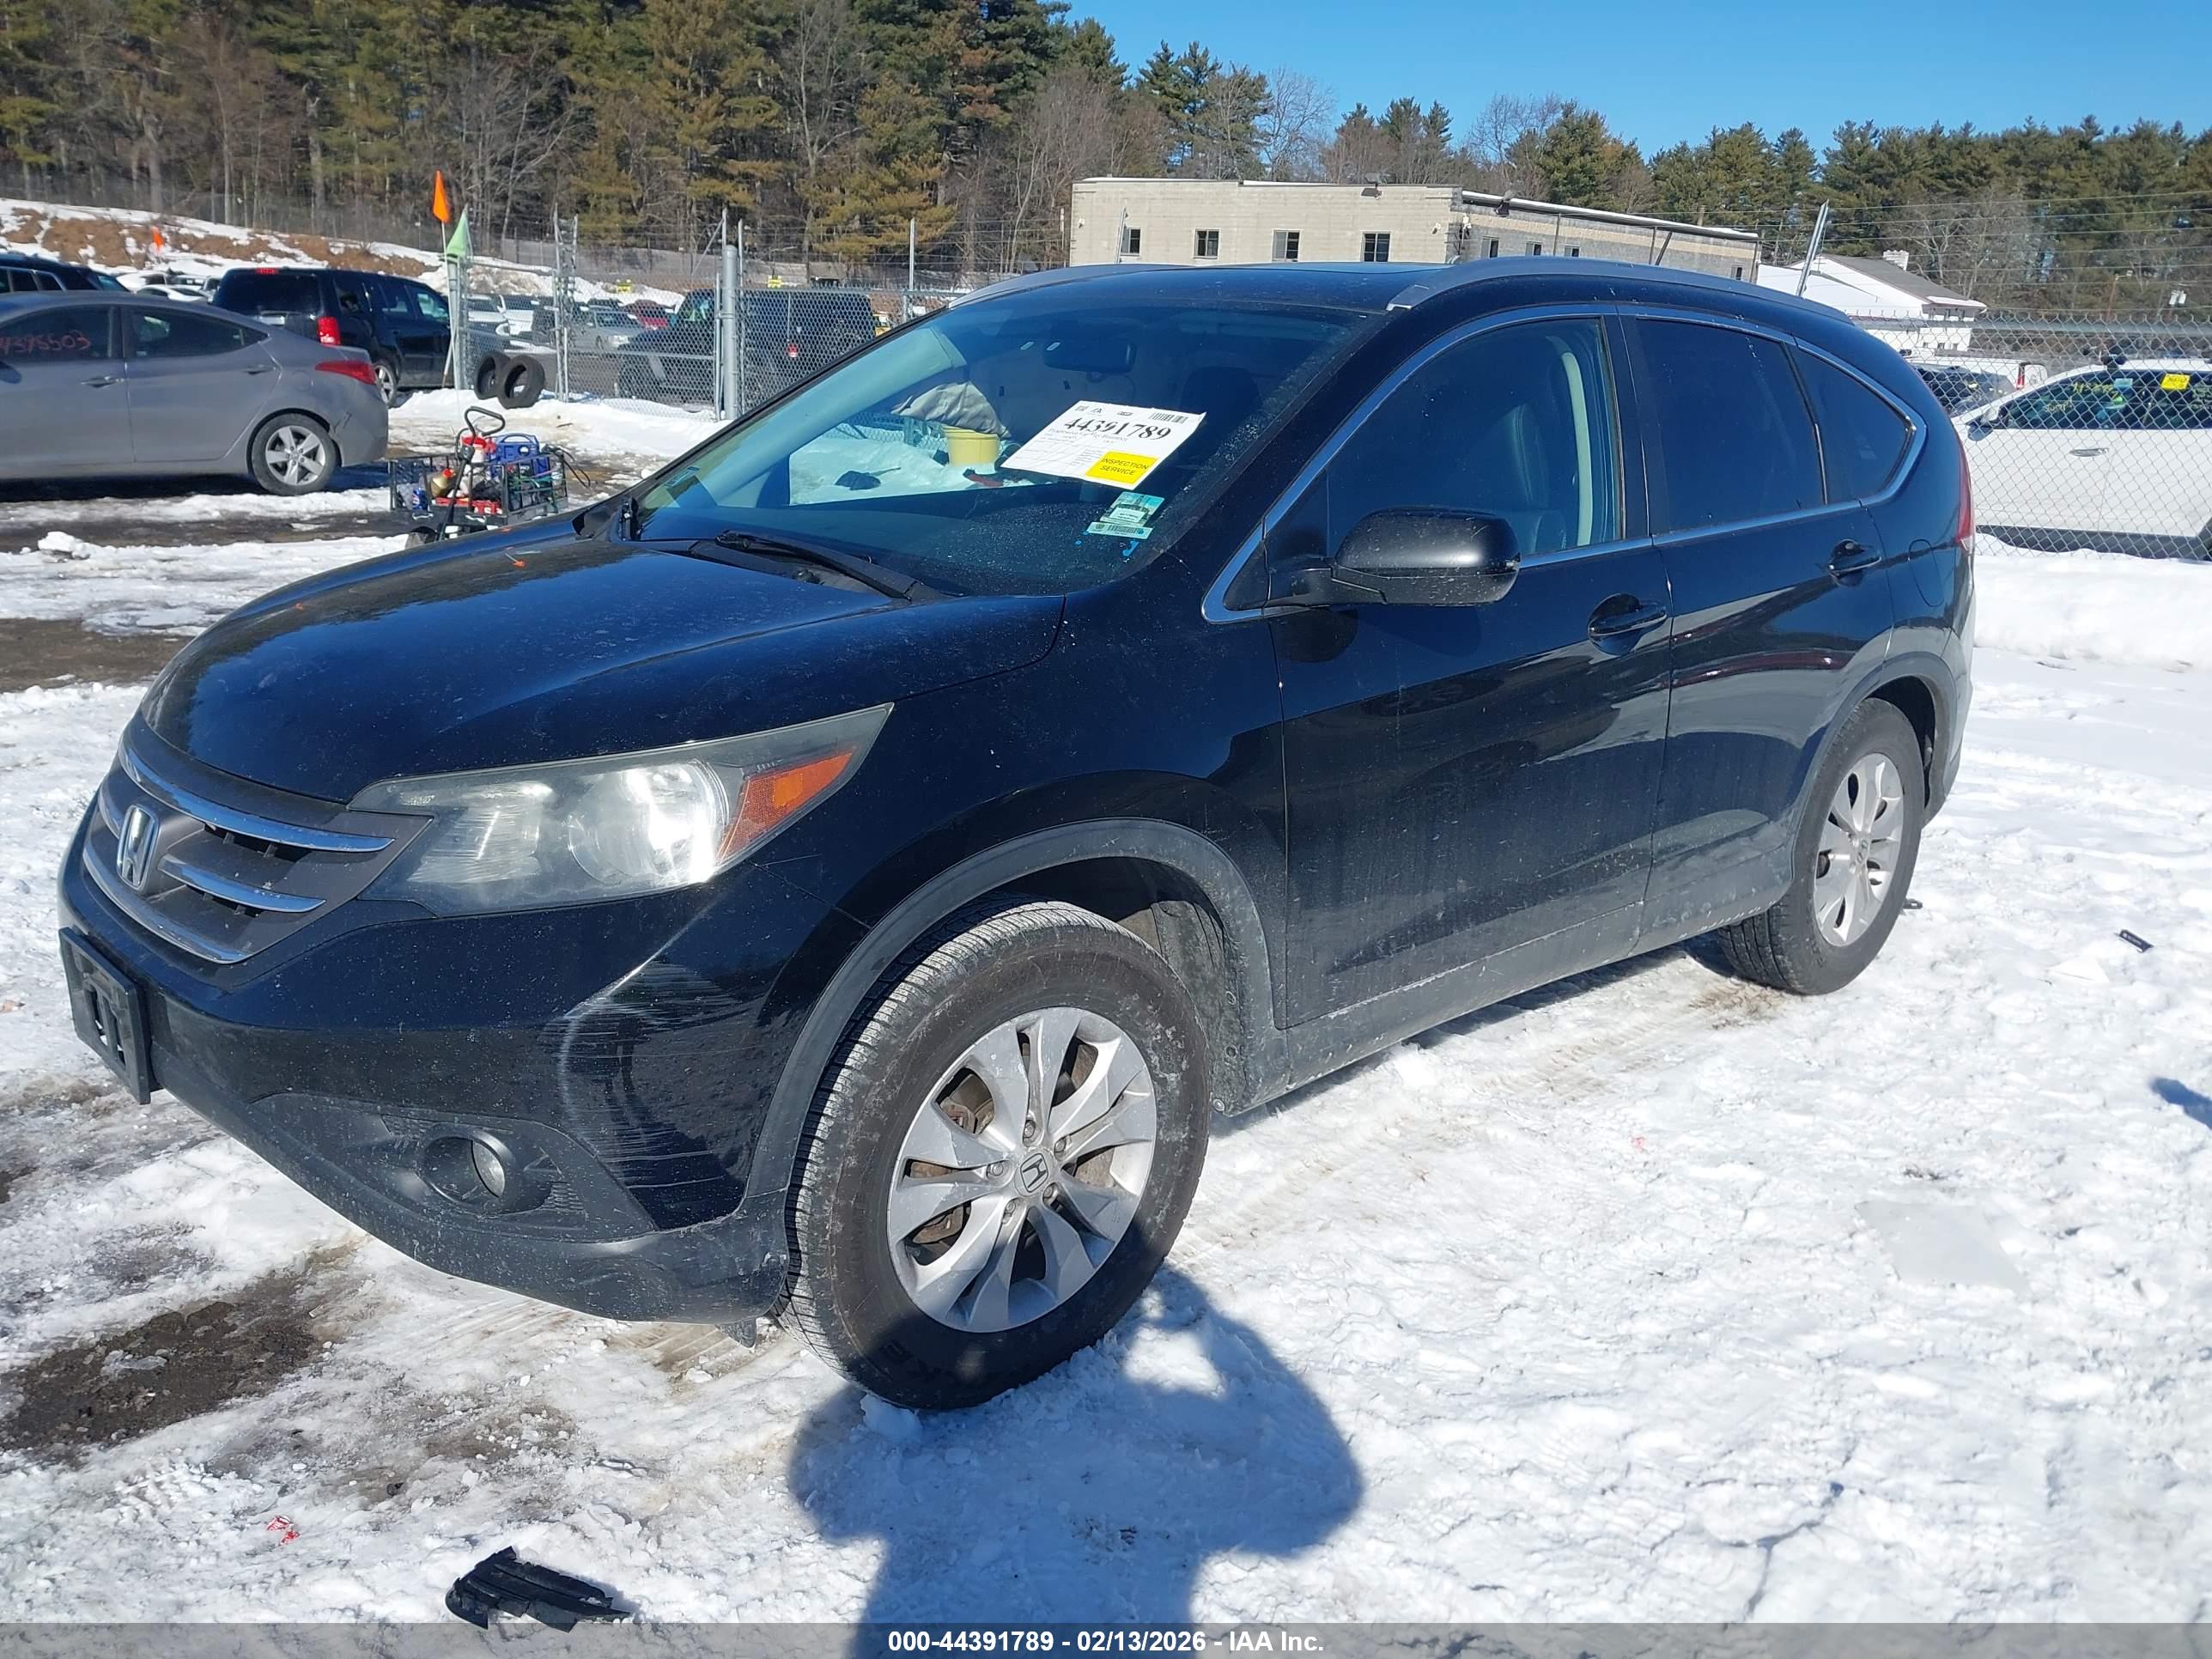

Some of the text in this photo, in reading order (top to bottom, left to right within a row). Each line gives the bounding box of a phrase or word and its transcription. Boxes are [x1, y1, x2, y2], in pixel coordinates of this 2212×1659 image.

[1064, 417, 1172, 441] 44391789
[1101, 458, 1150, 470] INSPECTION
[1100, 465, 1137, 476] SERVICE
